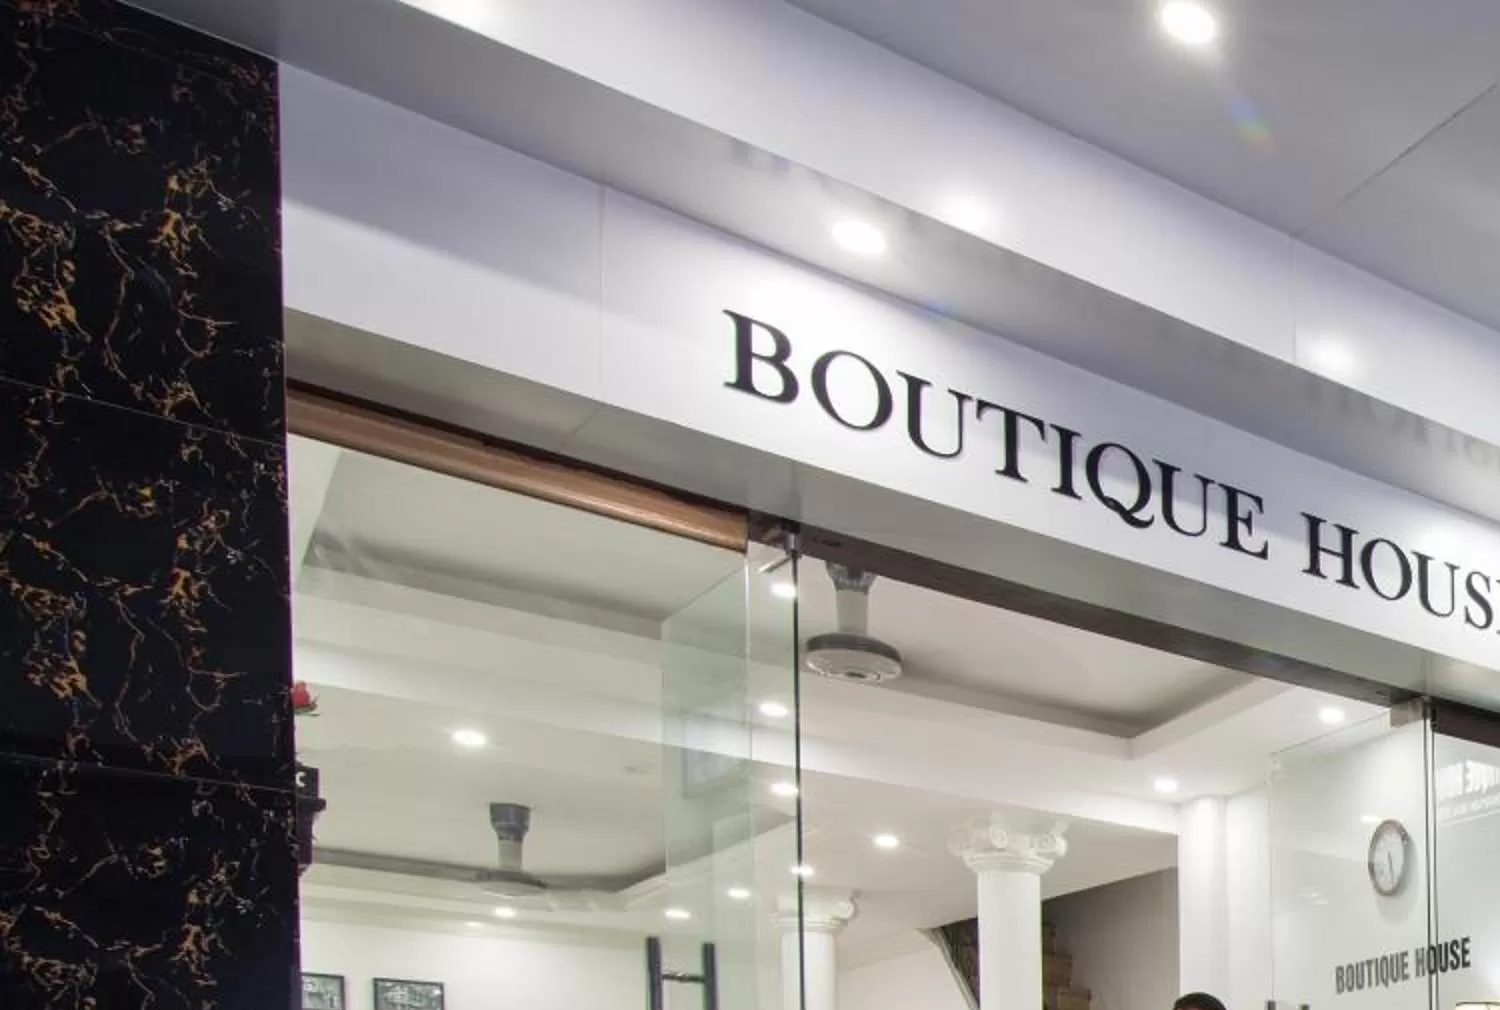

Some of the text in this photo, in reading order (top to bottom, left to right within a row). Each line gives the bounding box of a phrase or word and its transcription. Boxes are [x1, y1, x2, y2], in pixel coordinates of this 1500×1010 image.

[723, 309, 1270, 561] BOUTIQUE
[1335, 936, 1471, 995] BOUTIQUE HOUSE
